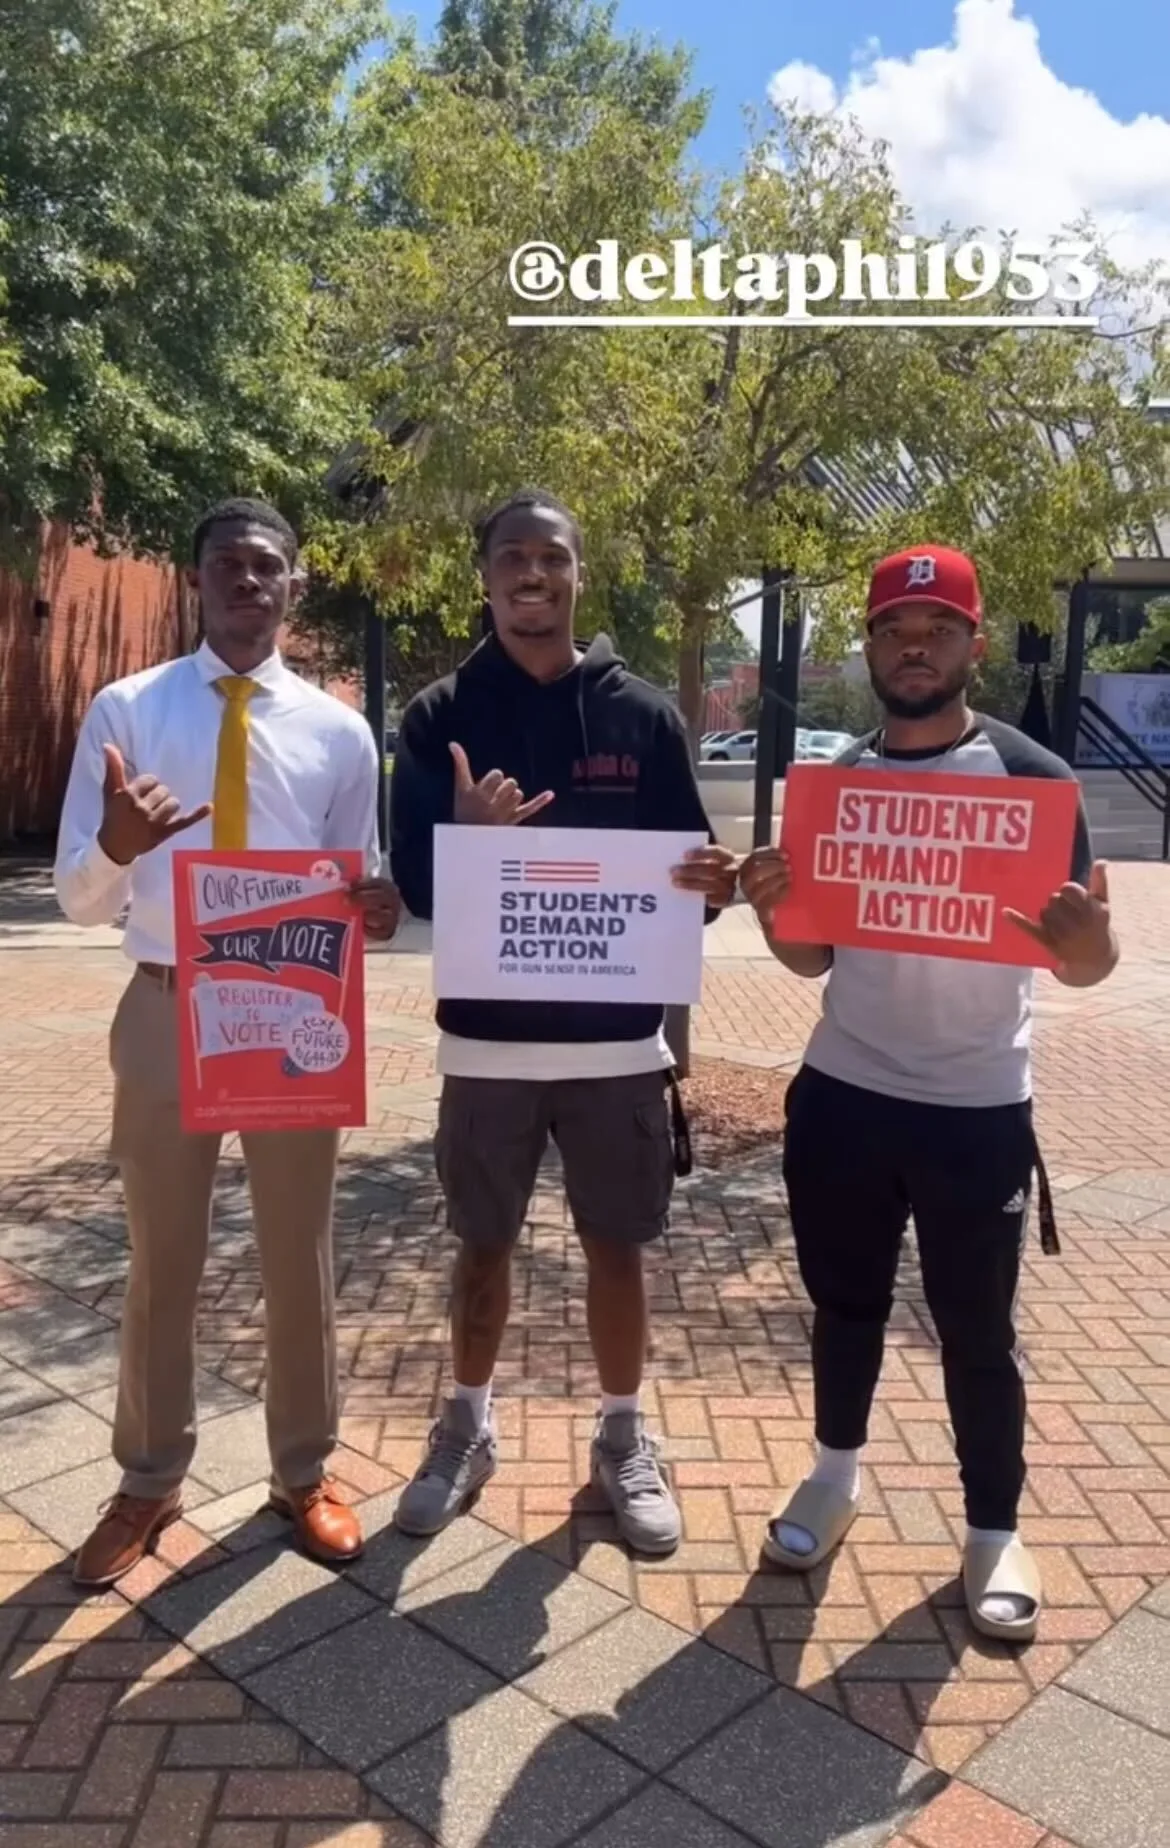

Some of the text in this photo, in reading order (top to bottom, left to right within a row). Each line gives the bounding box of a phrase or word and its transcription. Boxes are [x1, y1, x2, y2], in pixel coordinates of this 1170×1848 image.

[840, 793, 1026, 845] STUDENTS
[817, 839, 958, 886] DEMAND
[203, 873, 242, 909] OUR
[500, 891, 657, 914] STUDENTS
[862, 889, 989, 937] ACTION
[500, 915, 626, 936] DEMAND
[223, 924, 335, 965] OUR VOTE
[500, 939, 608, 960] ACTION
[499, 963, 636, 976] FOR GUN SENSE IN AMERICA
[217, 985, 293, 1007] REGISTER
[219, 1020, 283, 1046] VOTE
[291, 1028, 344, 1049] FUTURE
